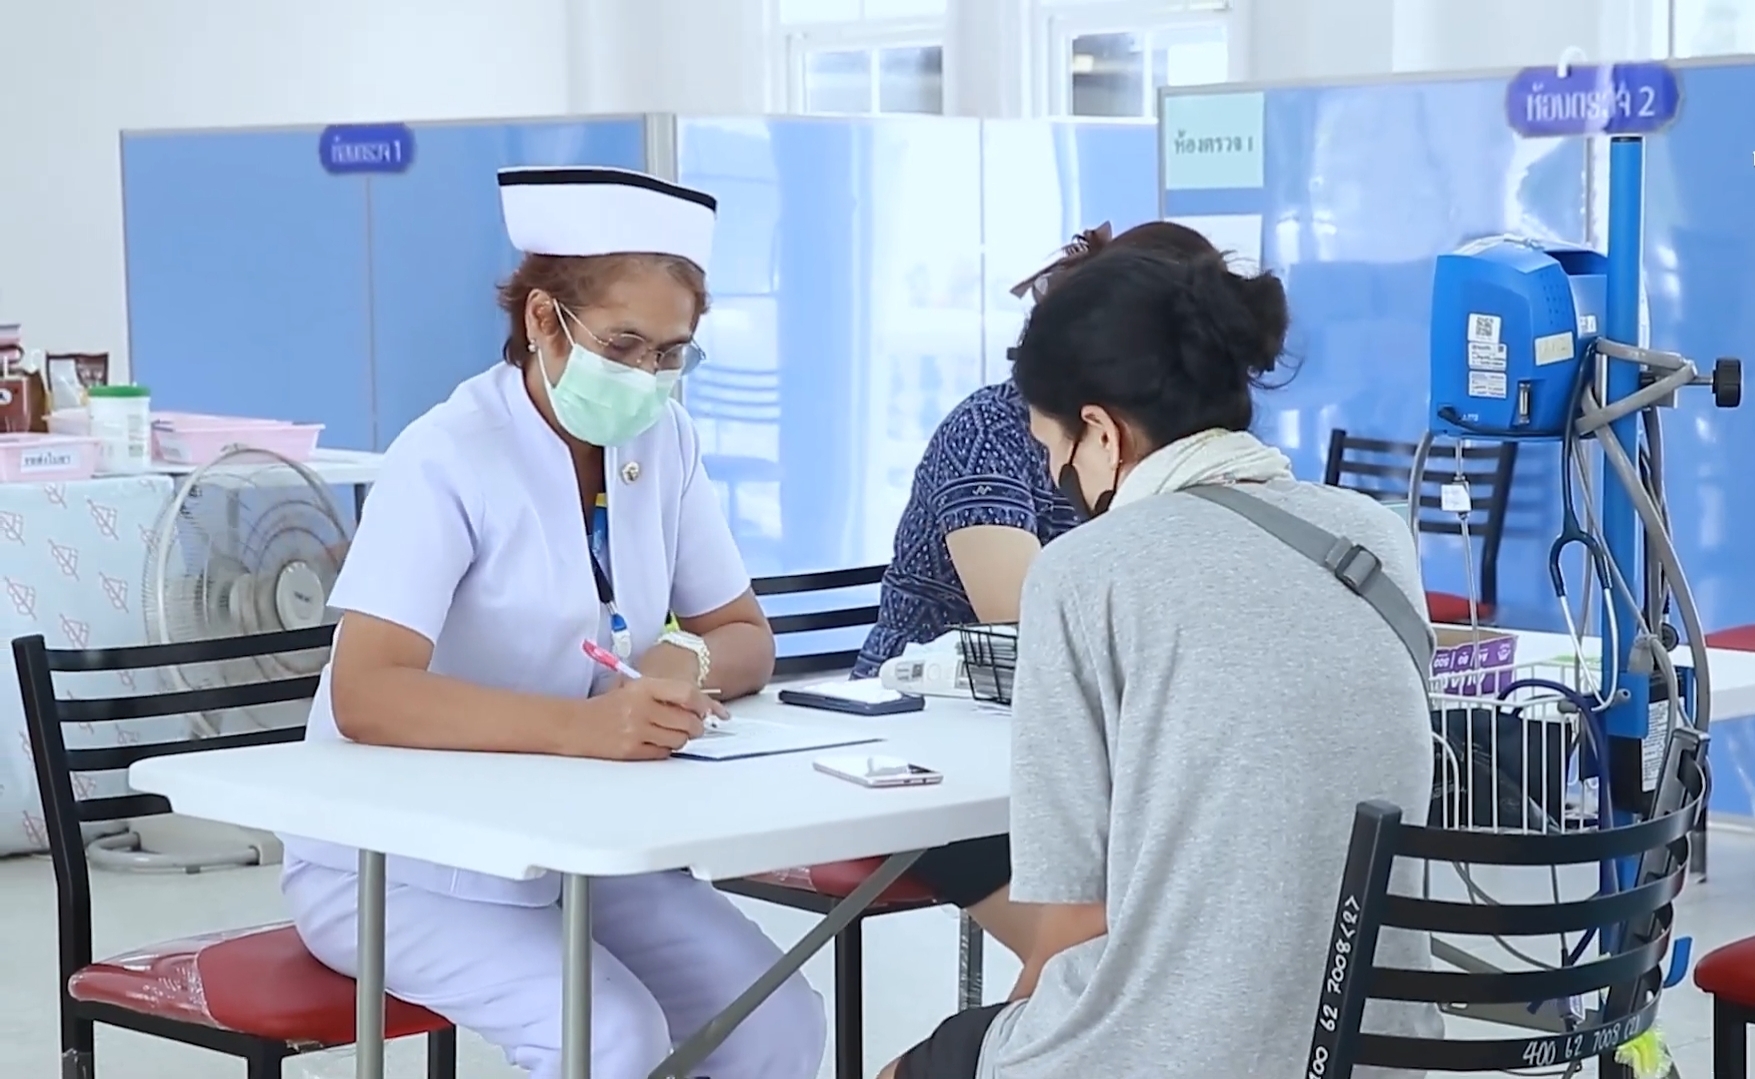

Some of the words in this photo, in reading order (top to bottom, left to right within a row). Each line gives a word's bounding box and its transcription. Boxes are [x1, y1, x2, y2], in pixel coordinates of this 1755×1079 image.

[1638, 86, 1656, 117] 2
[394, 140, 401, 162] 1
[1174, 129, 1242, 154] ห้องตรวจ
[1320, 1004, 1338, 1032] 62
[1523, 1041, 1556, 1066] 400
[1565, 1034, 1583, 1059] 62
